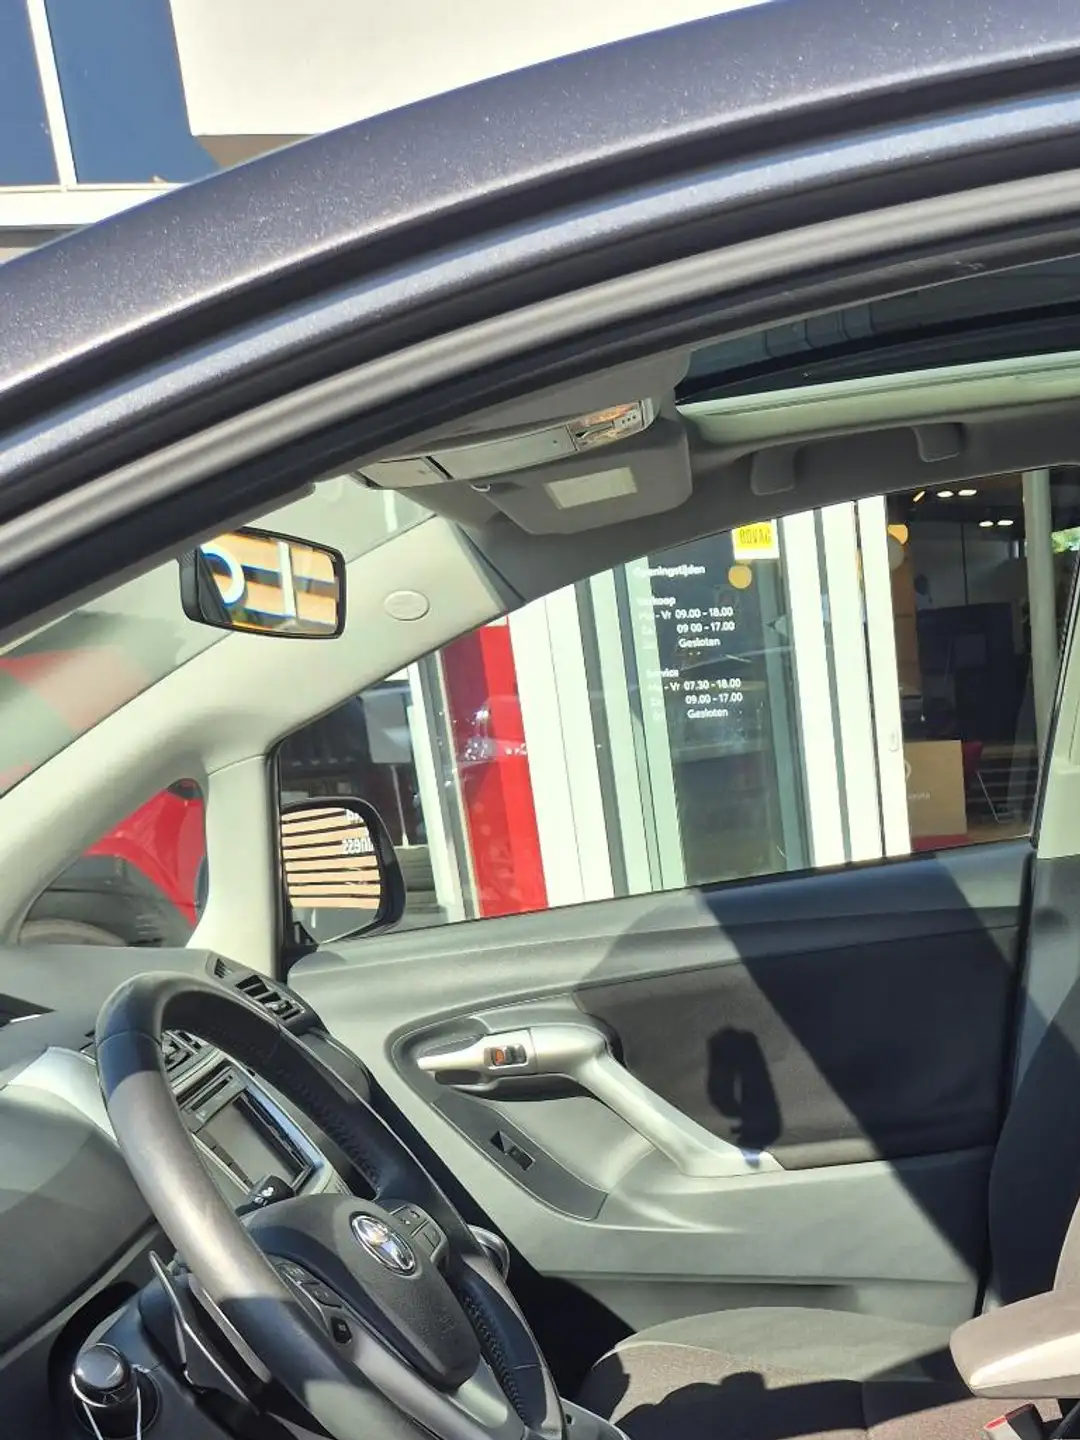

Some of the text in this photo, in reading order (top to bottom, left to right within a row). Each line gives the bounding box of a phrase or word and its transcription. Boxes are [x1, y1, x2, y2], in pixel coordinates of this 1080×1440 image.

[674, 608, 702, 619] 09.00
[709, 606, 734, 618] 18.00
[676, 622, 703, 634] 0900
[710, 620, 736, 632] 17.00
